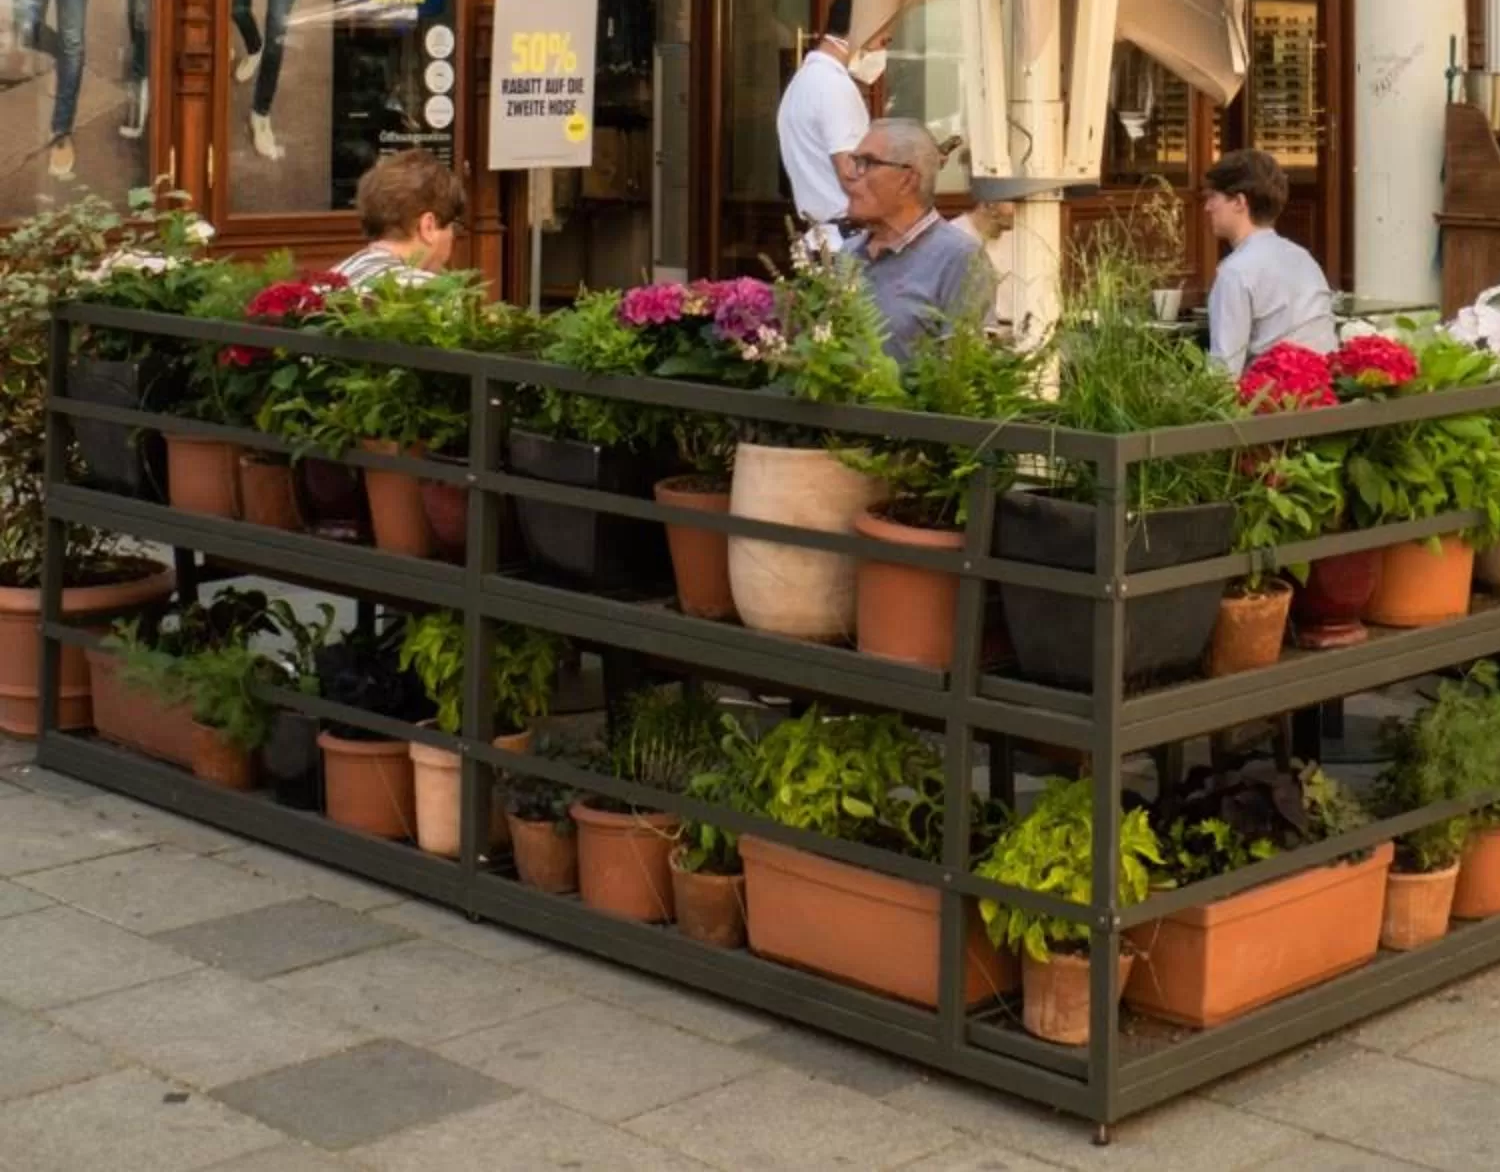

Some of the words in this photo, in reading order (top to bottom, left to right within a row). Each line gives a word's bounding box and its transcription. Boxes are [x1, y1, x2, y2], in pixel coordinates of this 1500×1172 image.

[511, 31, 577, 74] 50%
[502, 78, 542, 95] RABATT
[545, 78, 566, 95] AUF
[567, 78, 585, 94] DIE
[506, 99, 545, 117] ZWEITE
[548, 99, 577, 116] HOSE
